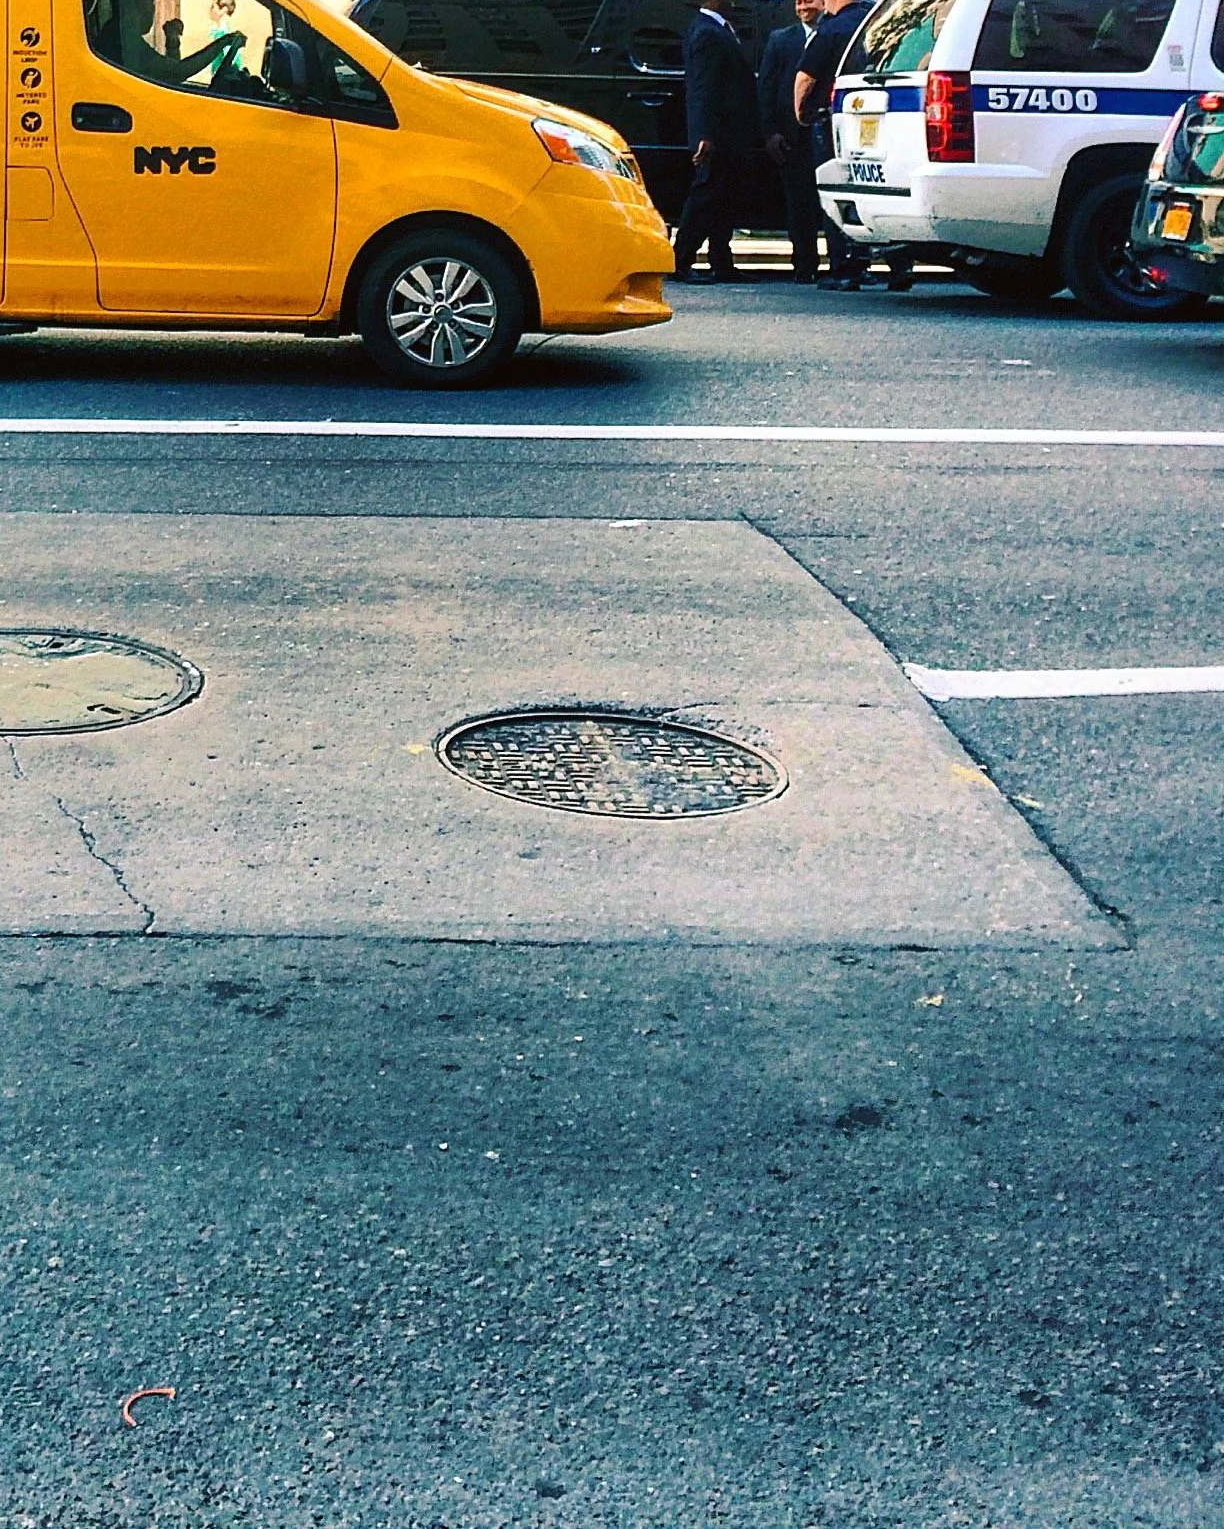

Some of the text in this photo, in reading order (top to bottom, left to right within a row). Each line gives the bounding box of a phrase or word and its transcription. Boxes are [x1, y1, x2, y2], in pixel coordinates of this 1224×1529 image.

[988, 87, 1098, 112] 57400
[134, 146, 217, 175] NYC
[852, 162, 886, 183] POLICE
